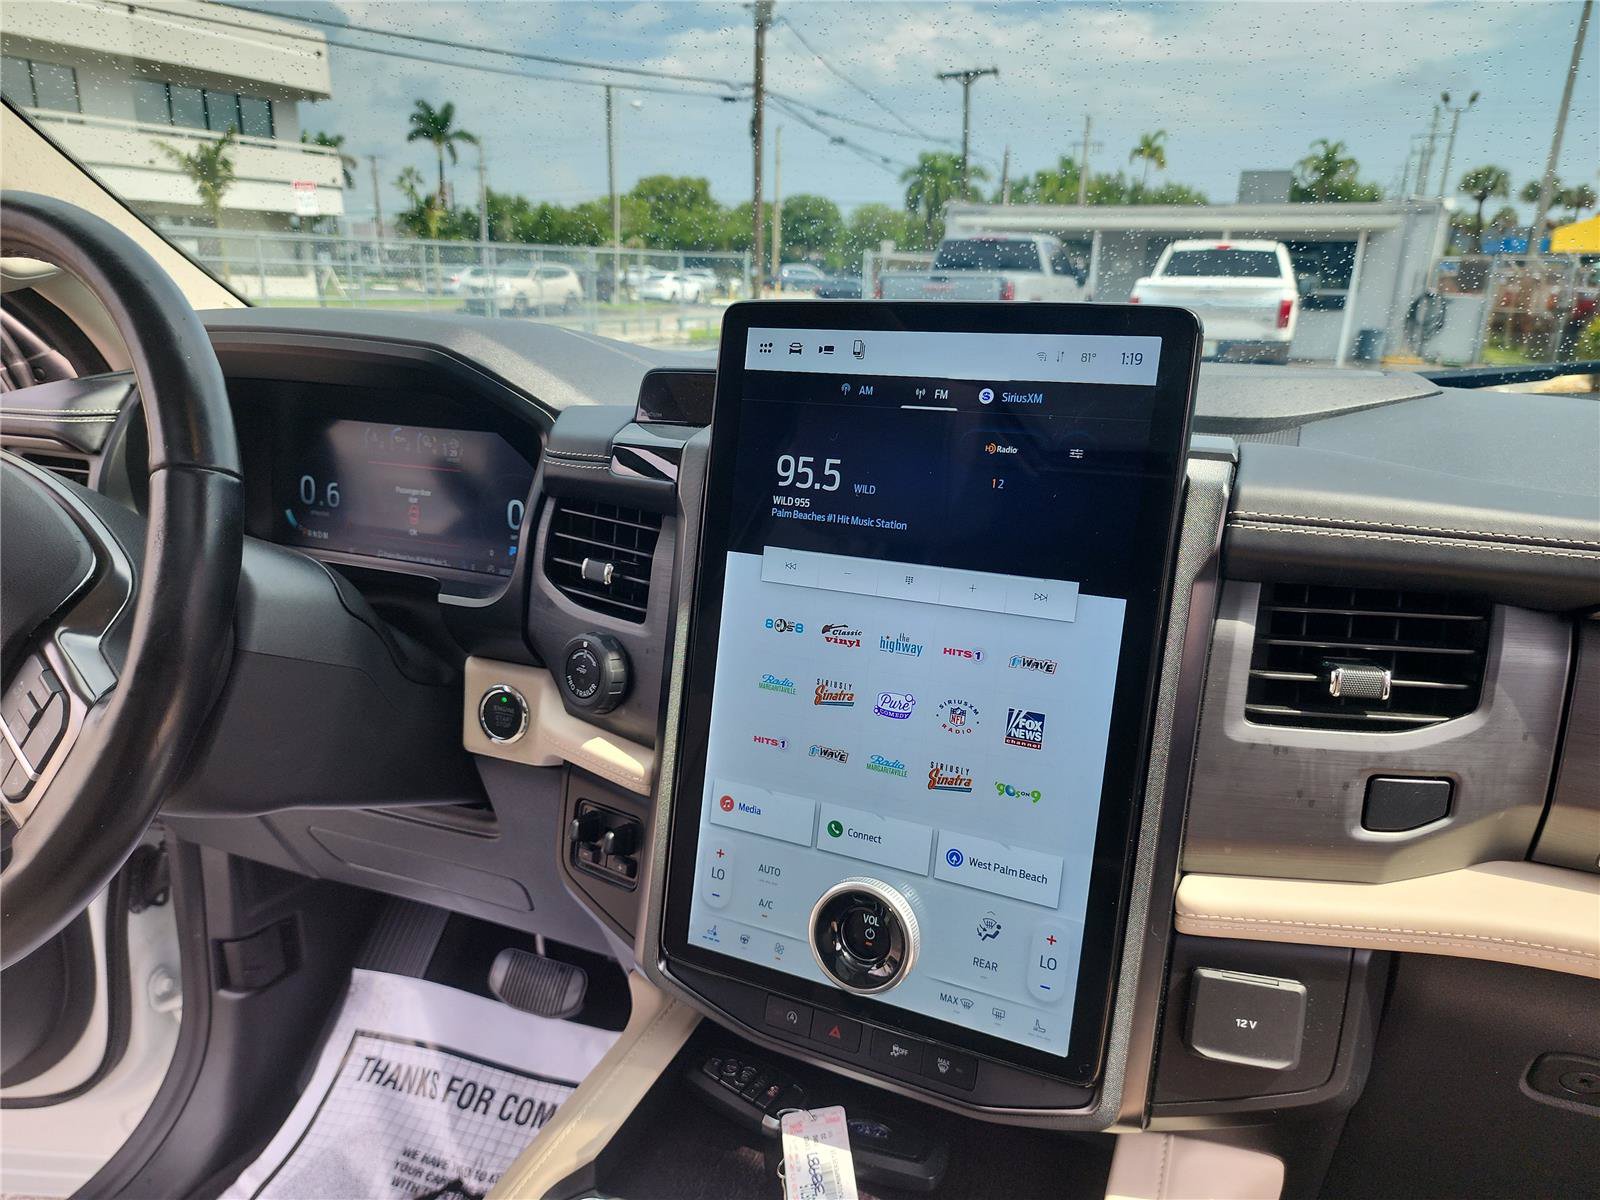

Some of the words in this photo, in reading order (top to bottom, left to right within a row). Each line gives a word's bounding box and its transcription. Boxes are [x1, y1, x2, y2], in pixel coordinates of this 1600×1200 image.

[1121, 352, 1143, 366] 1:19
[859, 385, 874, 395] AM
[934, 389, 949, 400] FM
[1002, 392, 1044, 404] SiriusXM
[996, 445, 1019, 454] Radio
[776, 454, 842, 492] 95.5
[853, 483, 876, 495] WILD
[794, 497, 811, 508] 955
[771, 507, 793, 518] Palm
[793, 509, 826, 522] Beaches
[827, 513, 837, 523] #1
[837, 514, 850, 525] Hit
[850, 516, 875, 528] Music
[875, 518, 908, 531] Station
[825, 636, 861, 648] vinyl
[900, 633, 910, 642] the
[879, 635, 923, 658] highway
[943, 647, 973, 659] HITS
[1021, 657, 1056, 674] WAVE
[761, 673, 794, 688] Radio
[816, 678, 853, 691] SIRIUSLY
[575, 683, 597, 697] TRAILER
[814, 685, 855, 706] Sinatra
[880, 693, 910, 711] Pure
[938, 699, 980, 716] SIRIUSXM
[878, 708, 909, 719] COMEDY
[950, 714, 966, 726] NFL
[941, 724, 973, 736] RADIO
[1018, 718, 1043, 732] FOX
[752, 735, 779, 747] HITS
[1010, 727, 1043, 743] NEWS
[1005, 738, 1041, 749] channel
[819, 747, 848, 762] WAVE
[870, 754, 905, 769] Radio
[930, 761, 970, 776] SIRIUSLY
[927, 767, 973, 790] Sinatra
[738, 802, 761, 815] Media
[847, 828, 882, 844] Connect
[711, 866, 725, 880] LO
[758, 863, 781, 877] AUTO
[969, 857, 992, 871] West
[993, 862, 1018, 878] Palm
[1018, 868, 1048, 885] Beach
[758, 898, 774, 910] A/C
[863, 913, 880, 927] VOL
[972, 956, 998, 972] REAR
[1040, 954, 1057, 971] LO
[940, 992, 959, 1006] MAX
[1235, 1018, 1248, 1029] 12
[1249, 1020, 1258, 1030] V
[357, 1055, 440, 1100] THANKS
[441, 1074, 497, 1116] FOR
